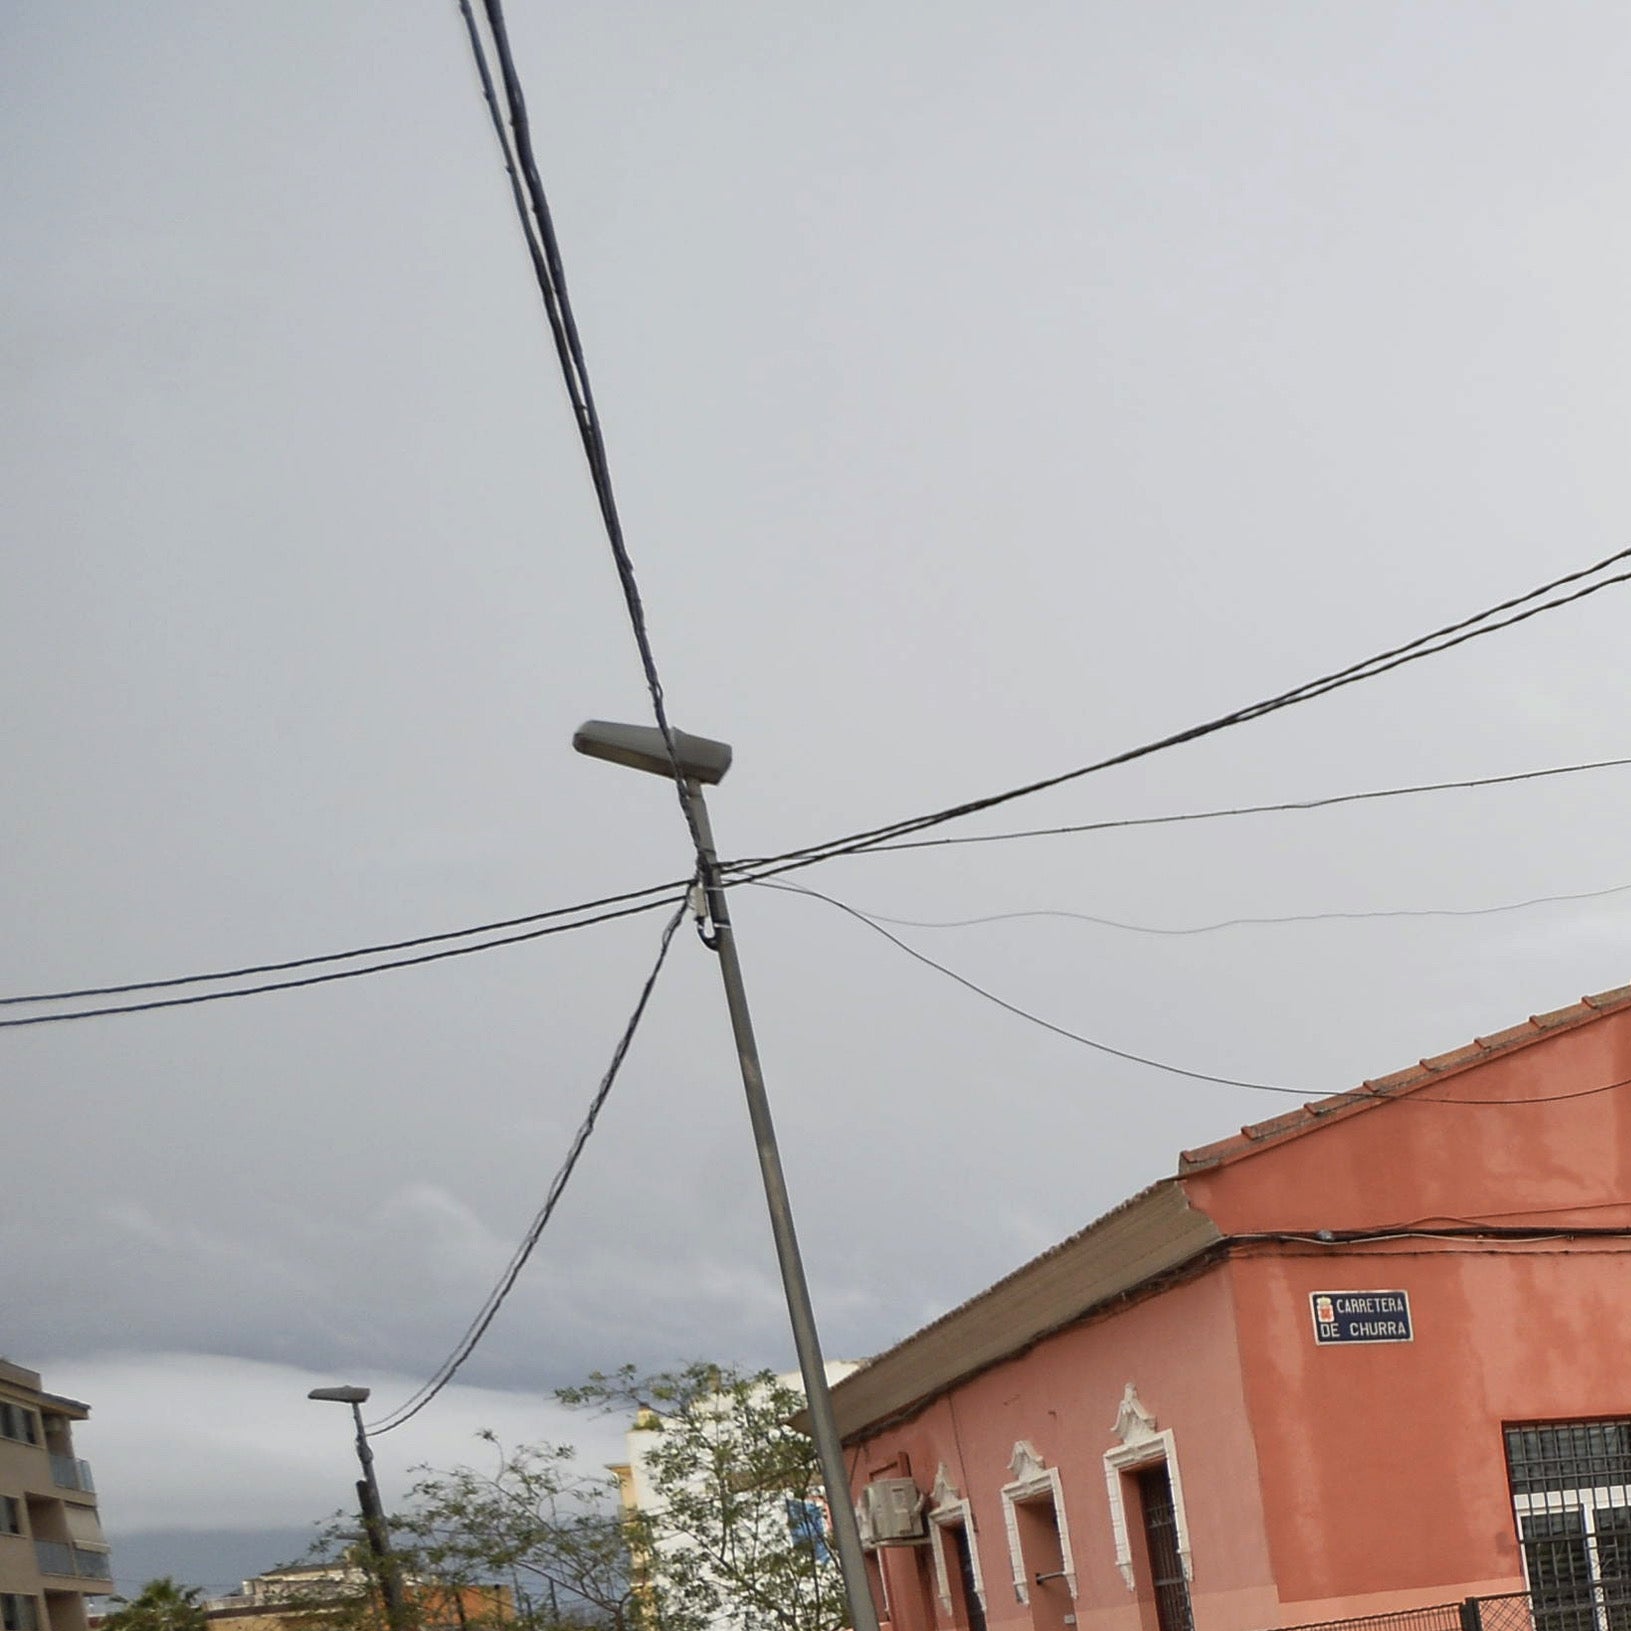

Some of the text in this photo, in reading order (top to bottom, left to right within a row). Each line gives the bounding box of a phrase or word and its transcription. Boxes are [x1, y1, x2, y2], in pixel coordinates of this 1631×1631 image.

[1336, 1297, 1404, 1314] CARRETERA
[1320, 1321, 1407, 1338] DE CHURRA
